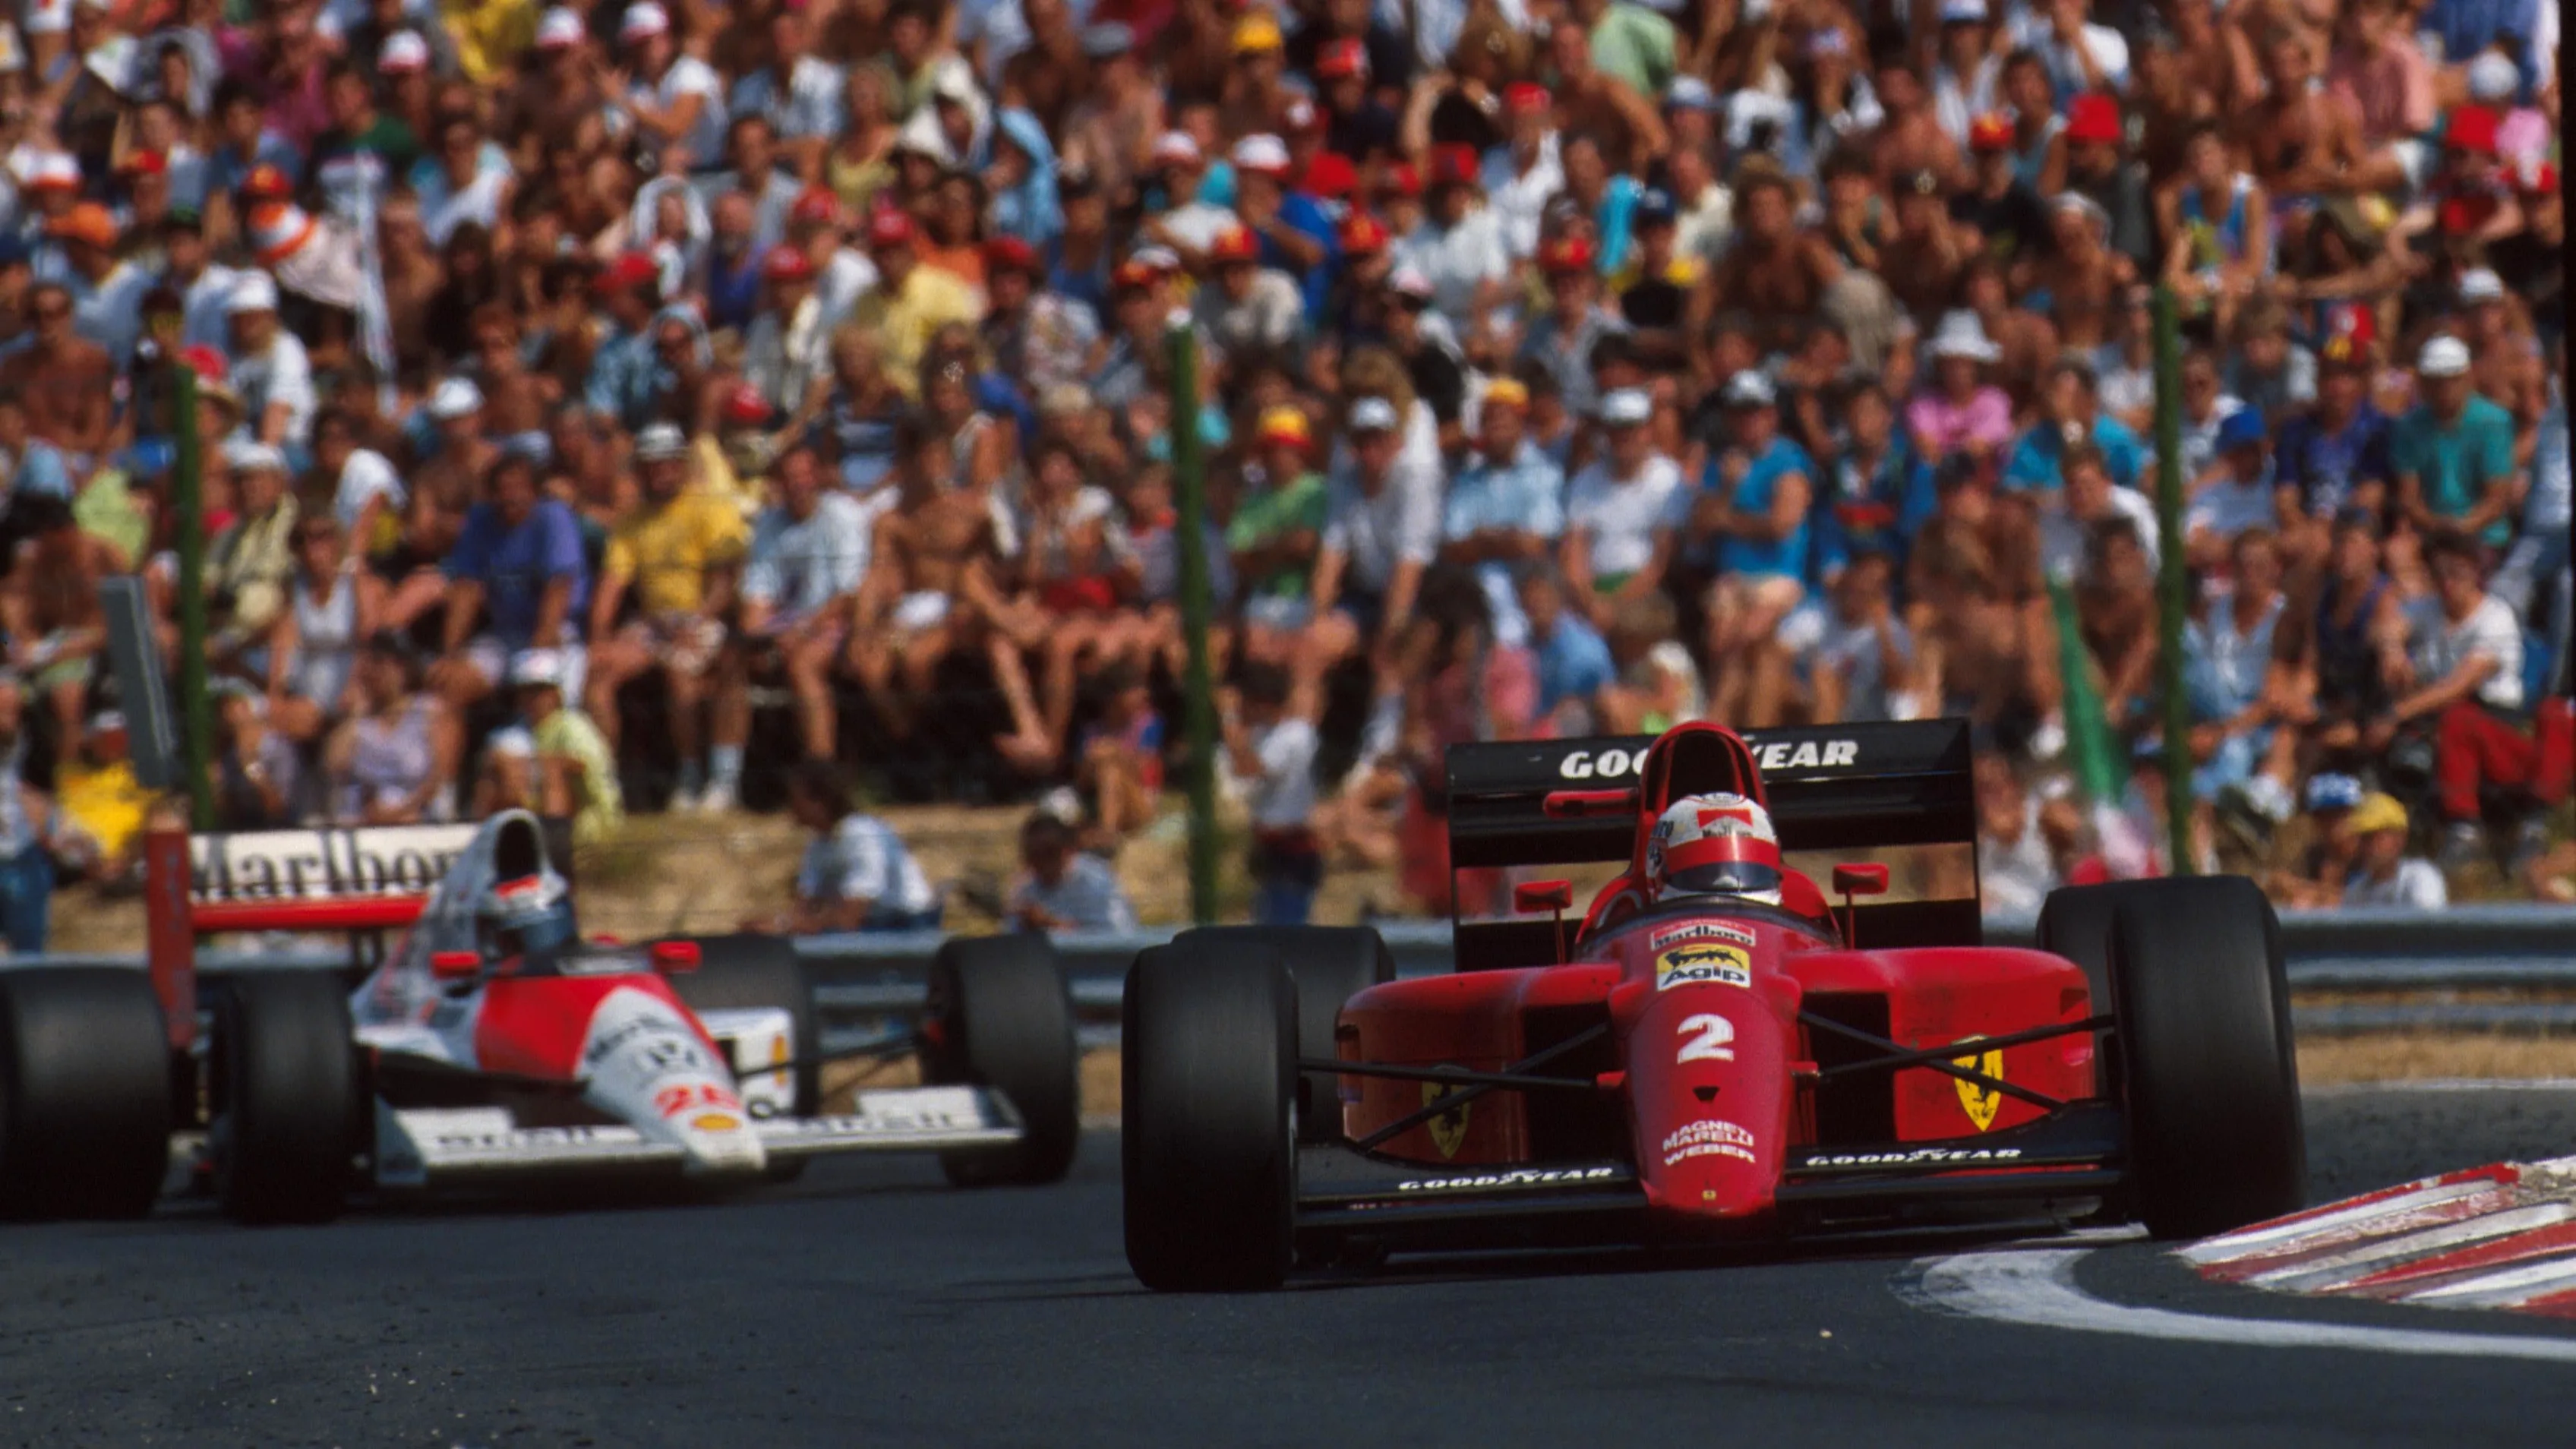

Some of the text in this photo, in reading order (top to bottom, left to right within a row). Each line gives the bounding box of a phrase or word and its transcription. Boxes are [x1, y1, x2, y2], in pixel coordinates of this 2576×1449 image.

[1662, 968, 1746, 987] Agip
[1677, 1013, 1735, 1064] 2
[1664, 1144, 1756, 1165] WEBER
[1807, 1148, 2021, 1166] GOODYEAR
[1398, 1168, 1613, 1190] GOODYEAR
